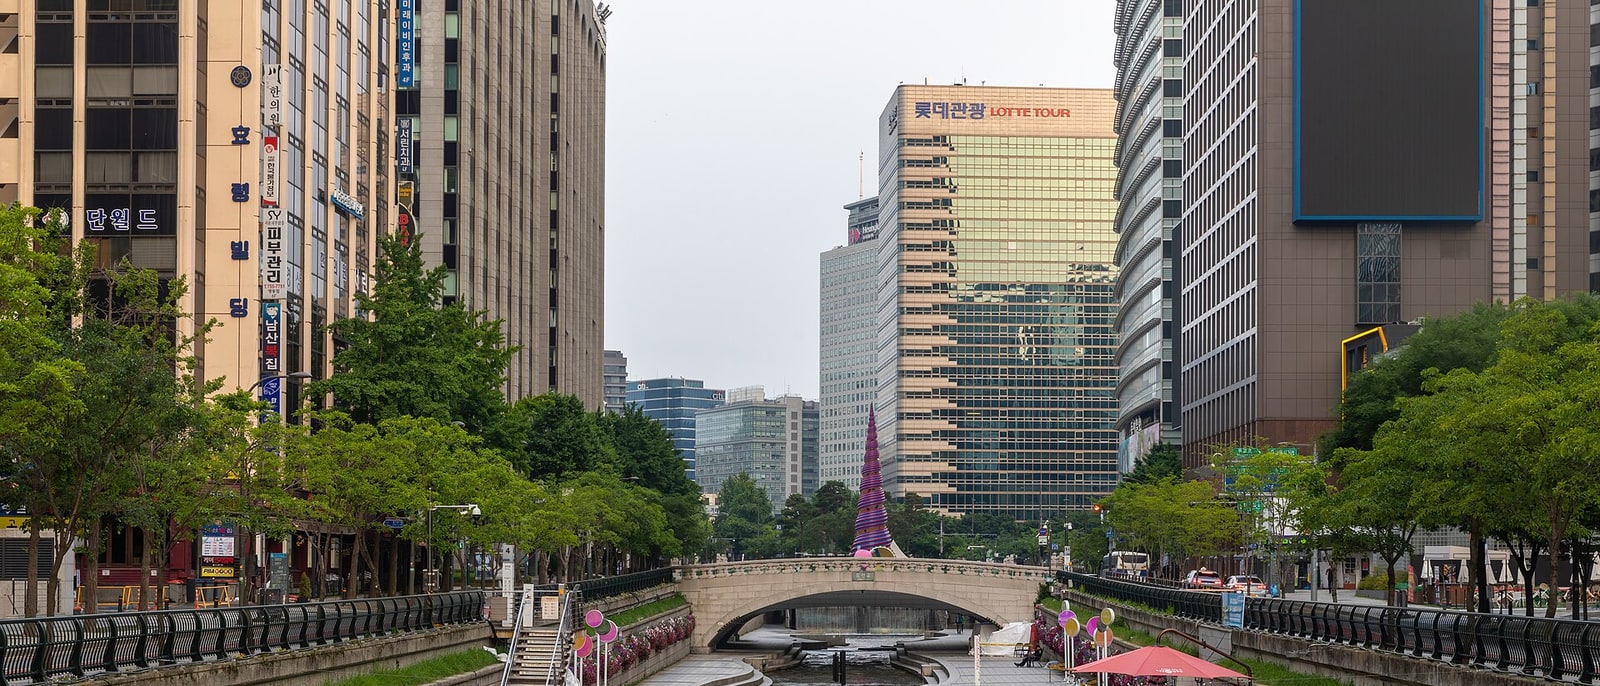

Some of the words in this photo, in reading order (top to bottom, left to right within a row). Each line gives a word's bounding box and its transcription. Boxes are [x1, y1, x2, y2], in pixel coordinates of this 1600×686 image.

[915, 102, 986, 119] 롯데관광
[990, 107, 1031, 117] LOTTE
[1033, 108, 1071, 118] TOUR
[400, 129, 409, 166] 서린치과
[86, 208, 158, 231] 단월드
[230, 124, 251, 318] 효령빌딩
[268, 210, 281, 220] SY
[267, 227, 281, 283] 피부관리
[265, 320, 279, 370] 남산복집
